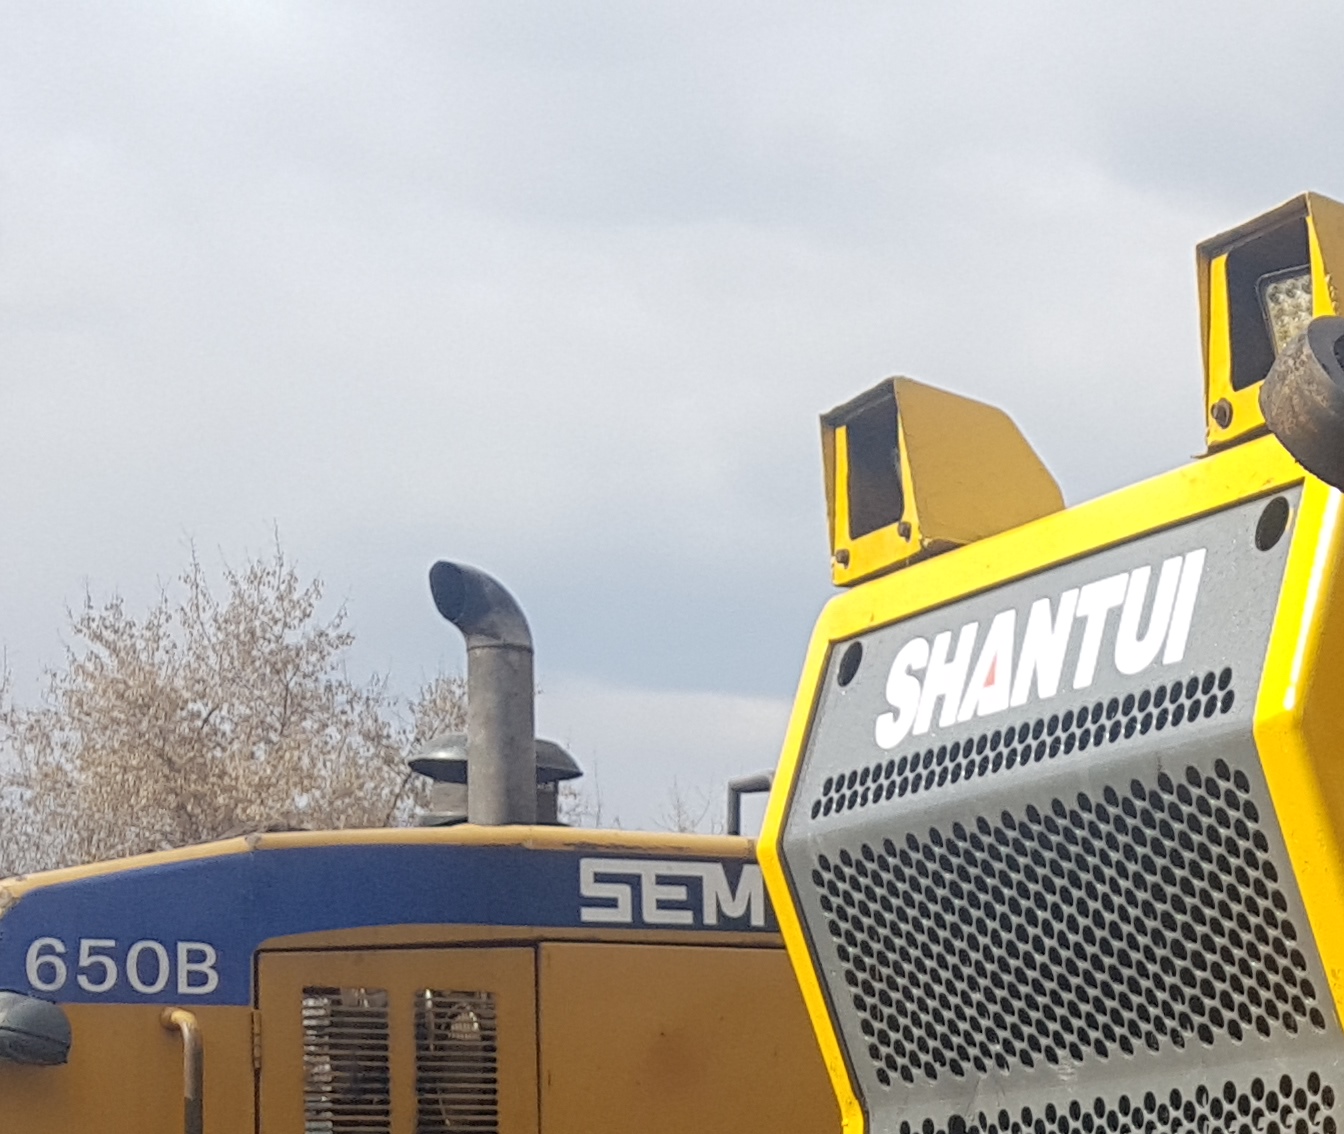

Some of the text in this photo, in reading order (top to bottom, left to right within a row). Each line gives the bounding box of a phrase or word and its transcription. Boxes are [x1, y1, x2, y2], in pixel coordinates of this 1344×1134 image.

[874, 548, 1207, 750] SHANTUI
[579, 857, 765, 927] SEM
[25, 938, 220, 994] 650B
